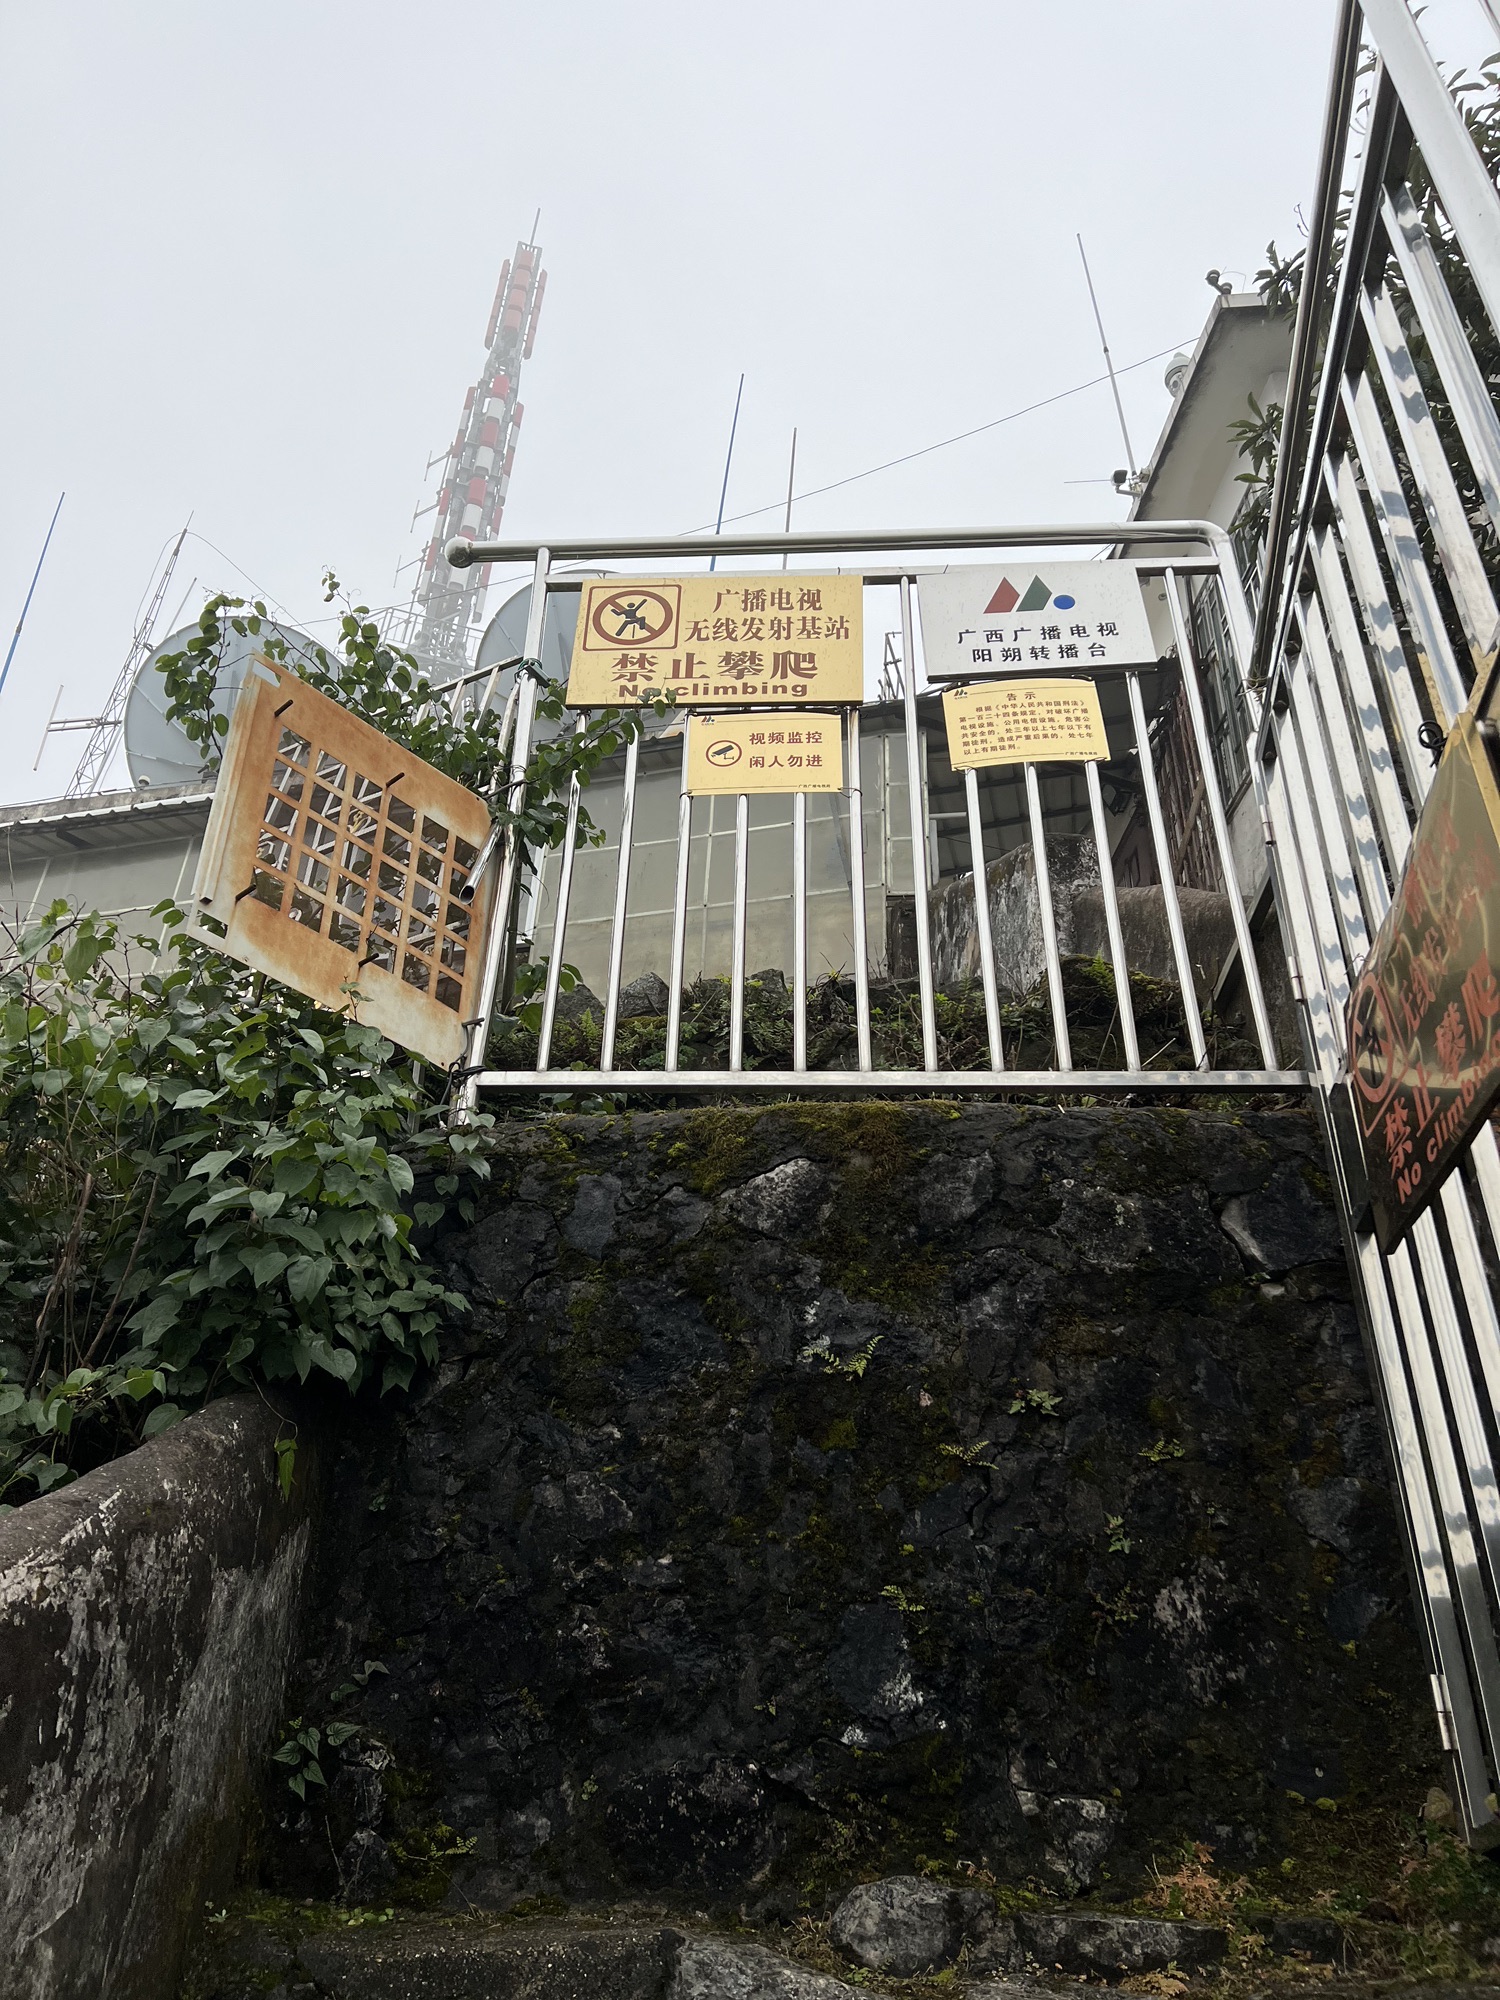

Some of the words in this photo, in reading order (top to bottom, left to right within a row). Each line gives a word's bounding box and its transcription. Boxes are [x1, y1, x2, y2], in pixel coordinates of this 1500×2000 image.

[713, 588, 823, 613] 广播电视
[684, 615, 850, 642] 无线发射基站
[957, 622, 1119, 644] 广西广播电视
[972, 642, 1107, 662] 阳朔转播台
[610, 650, 818, 682] 禁止攀爬
[675, 682, 808, 697] climbing
[1006, 691, 1036, 701] 告示
[976, 700, 1085, 712] 根据《中华人民共和国刑法》
[749, 731, 823, 746] 视频监控
[749, 755, 823, 768] 闲人勿进
[1397, 1161, 1422, 1204] No
